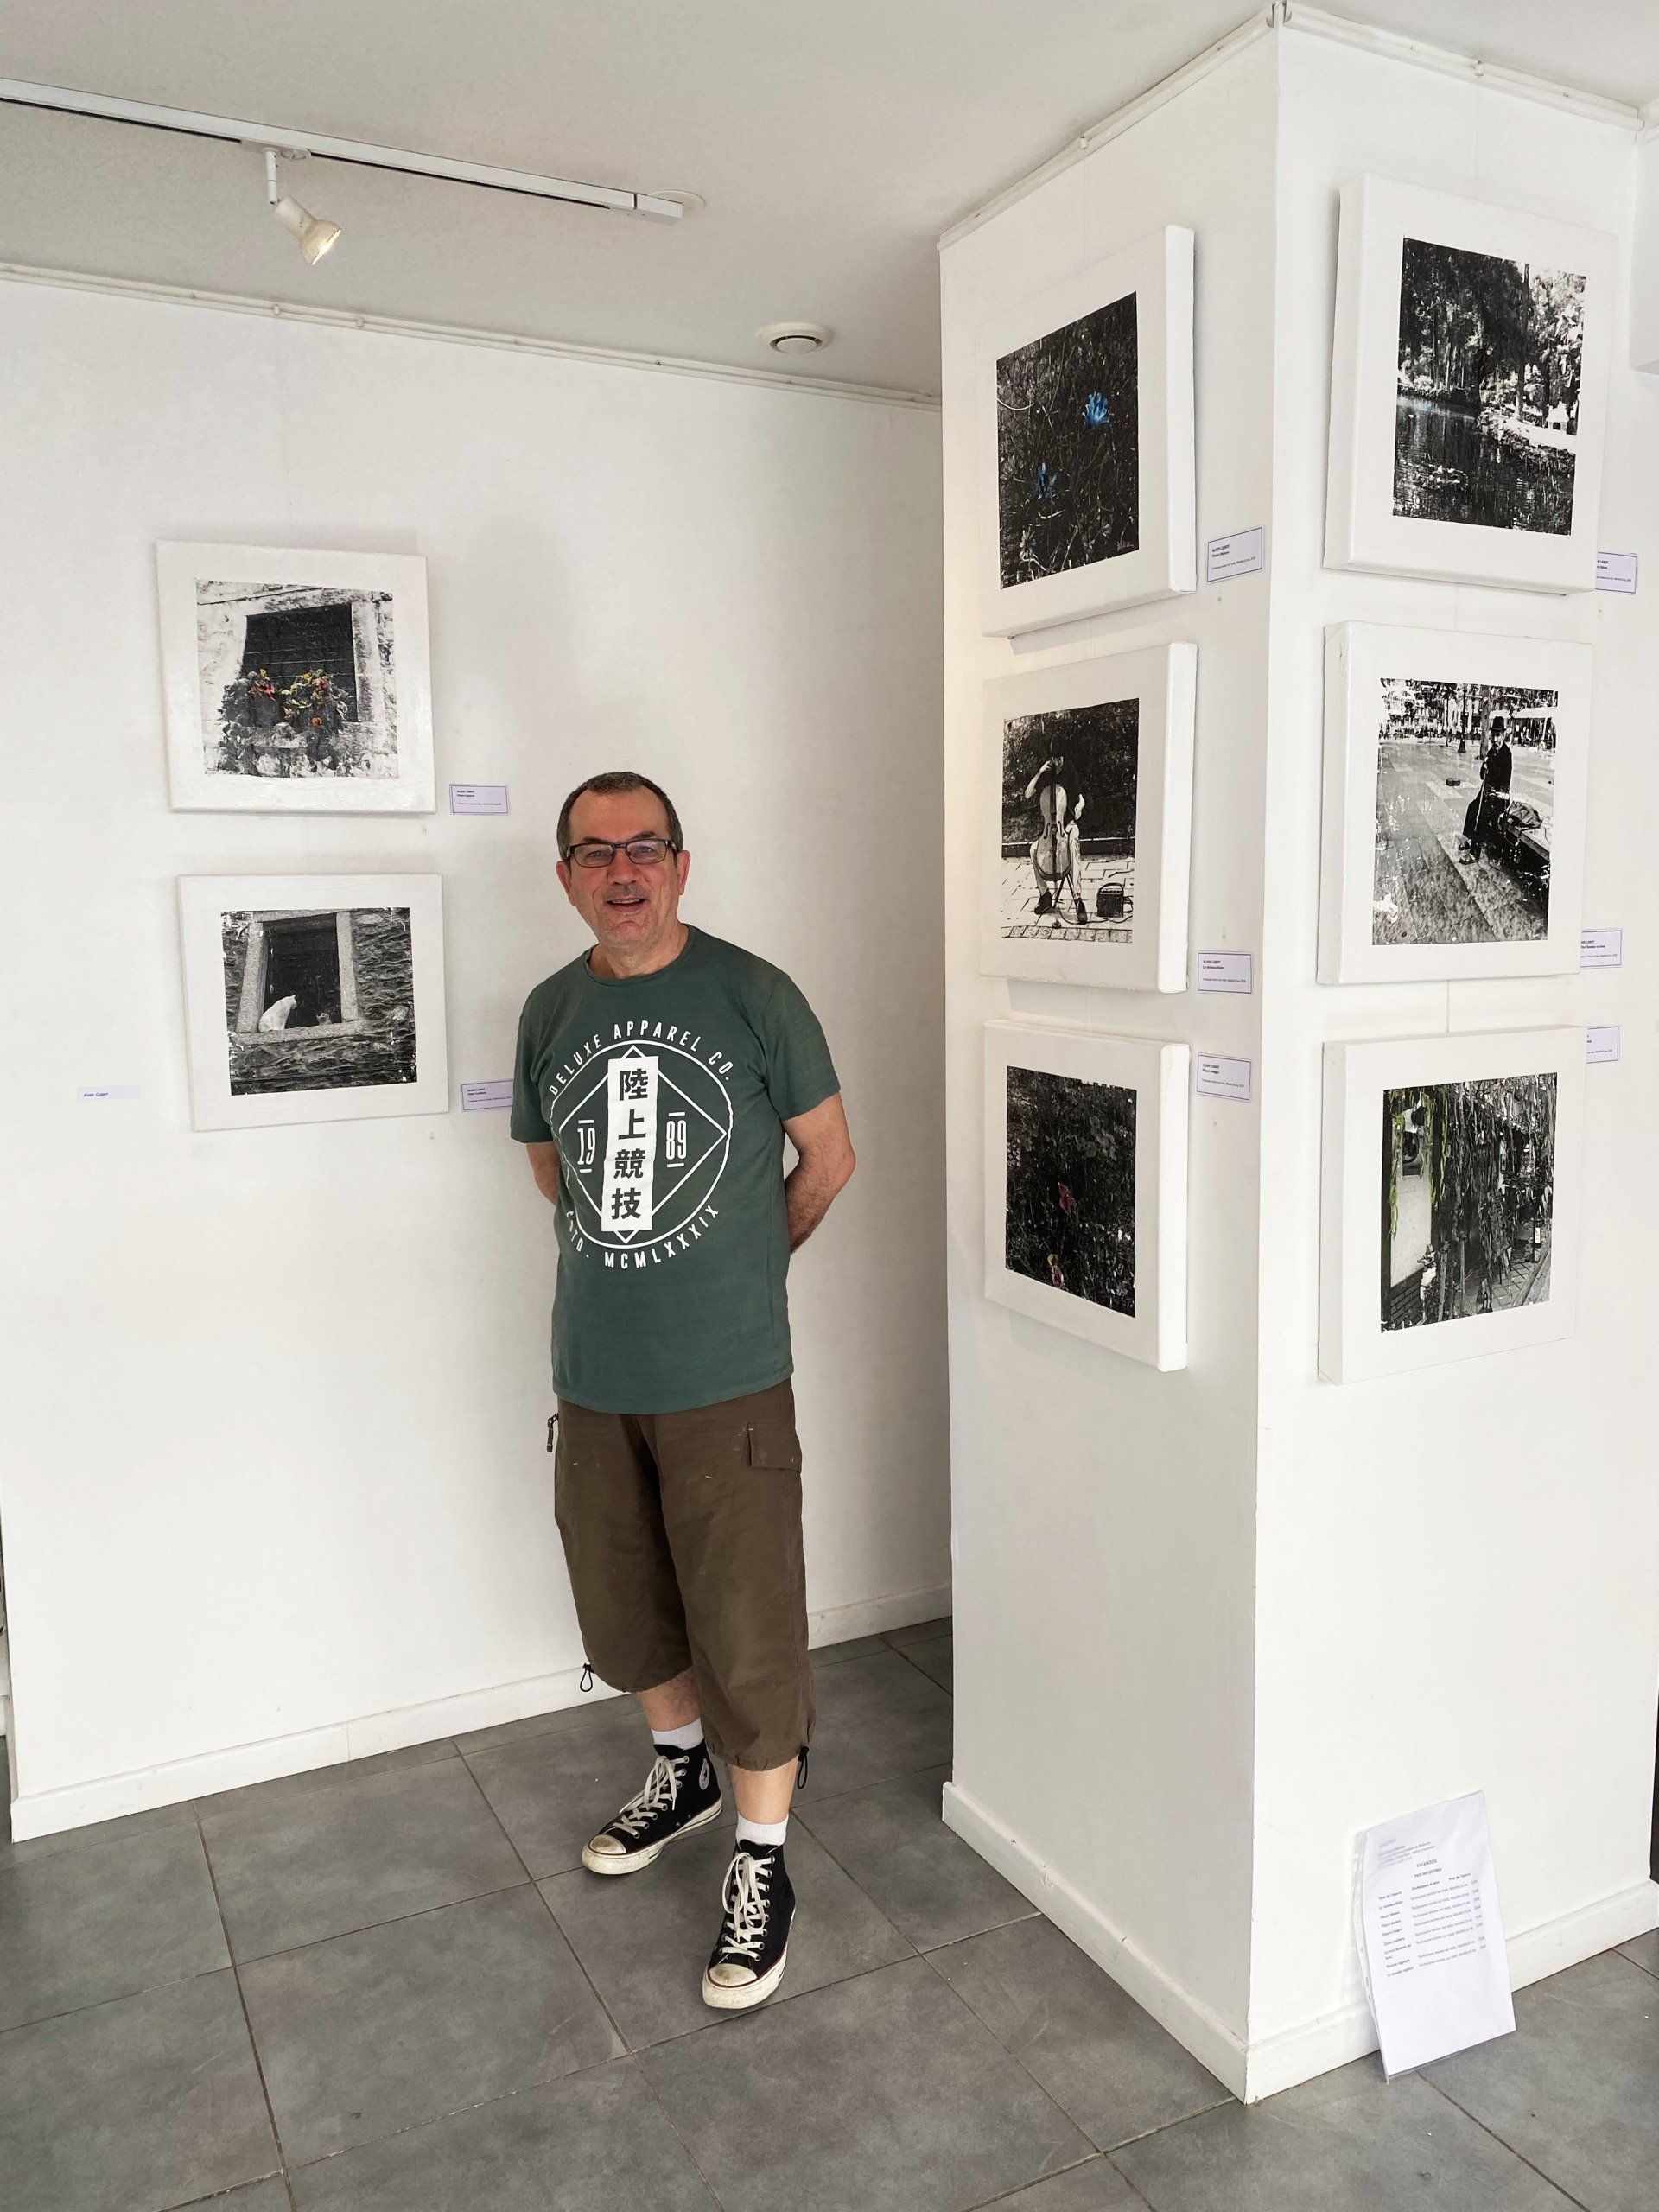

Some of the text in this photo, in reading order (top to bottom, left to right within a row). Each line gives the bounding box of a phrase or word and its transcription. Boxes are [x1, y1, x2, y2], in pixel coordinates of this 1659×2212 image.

[550, 1020, 734, 1096] DELUXE APPAREL CO.
[577, 1127, 596, 1166] 19
[611, 1068, 649, 1221] 陸上競技
[665, 1119, 687, 1160] 89
[604, 1204, 719, 1270] MCMLXXXIX
